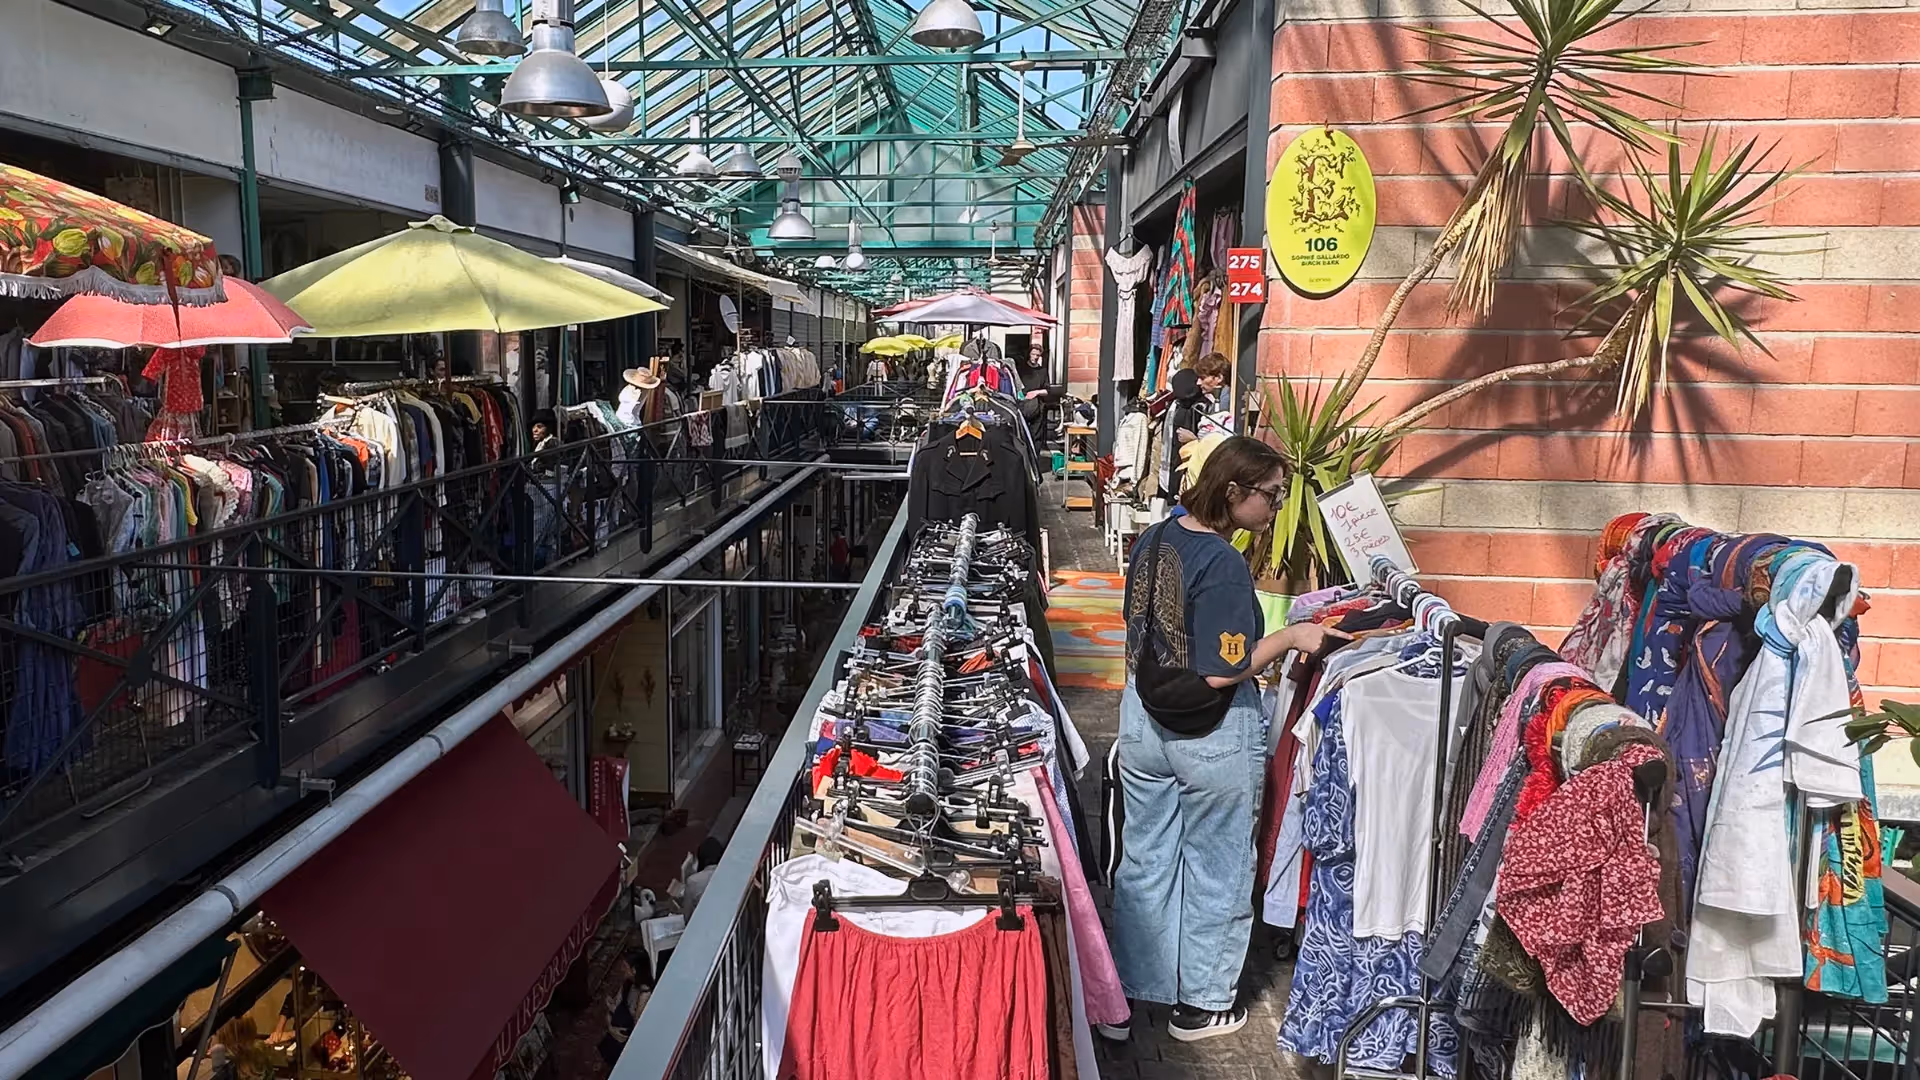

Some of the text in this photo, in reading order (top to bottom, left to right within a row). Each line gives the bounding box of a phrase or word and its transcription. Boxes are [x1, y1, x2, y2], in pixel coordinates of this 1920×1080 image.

[1305, 237, 1338, 252] 106
[1228, 255, 1260, 269] 275
[1230, 282, 1263, 296] 274
[1330, 501, 1359, 521] 10€
[1344, 528, 1371, 547] 25€
[1350, 547, 1360, 558] 3
[1228, 643, 1238, 655] H
